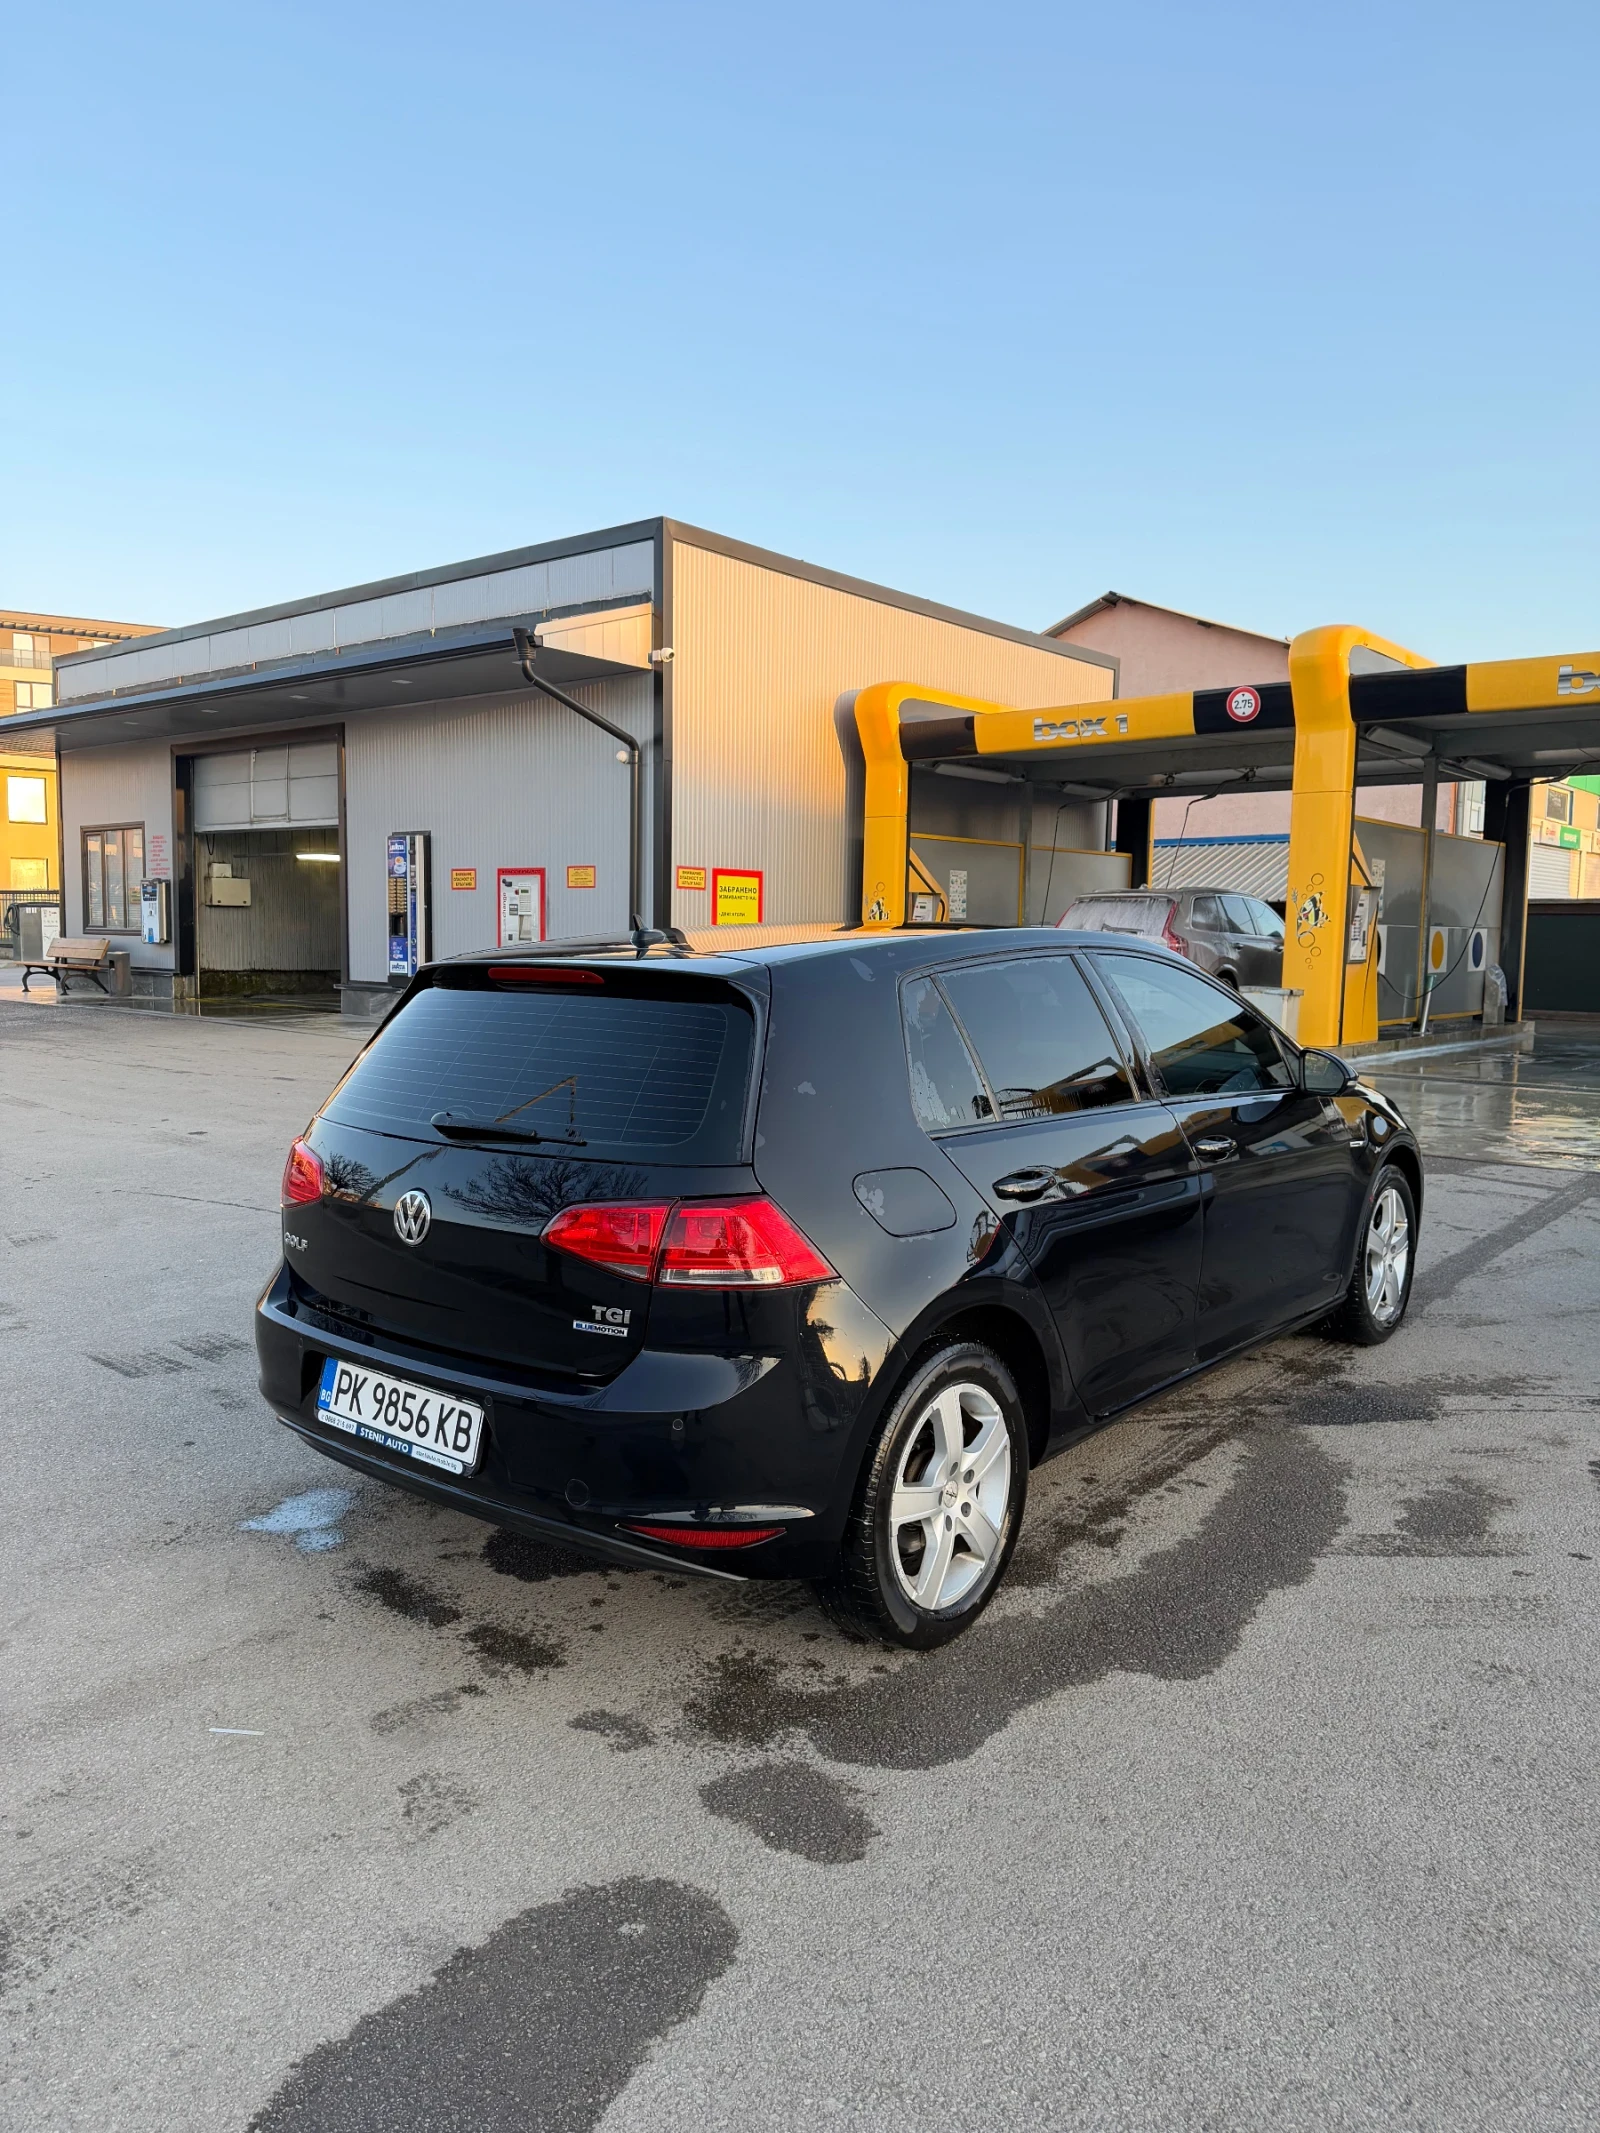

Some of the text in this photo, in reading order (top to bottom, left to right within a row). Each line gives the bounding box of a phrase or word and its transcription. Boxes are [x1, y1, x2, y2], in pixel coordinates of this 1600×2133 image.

[1557, 664, 1600, 696] b
[1234, 699, 1253, 710] 2.75
[1033, 713, 1129, 741] box 1
[719, 885, 757, 894] ЗАБРАНЕНО
[284, 1231, 308, 1252] GOLF
[592, 1305, 632, 1324] TGI
[320, 1389, 331, 1402] BG
[334, 1368, 473, 1453] PK 9856 KB
[360, 1427, 409, 1453] STENLI AUTO
